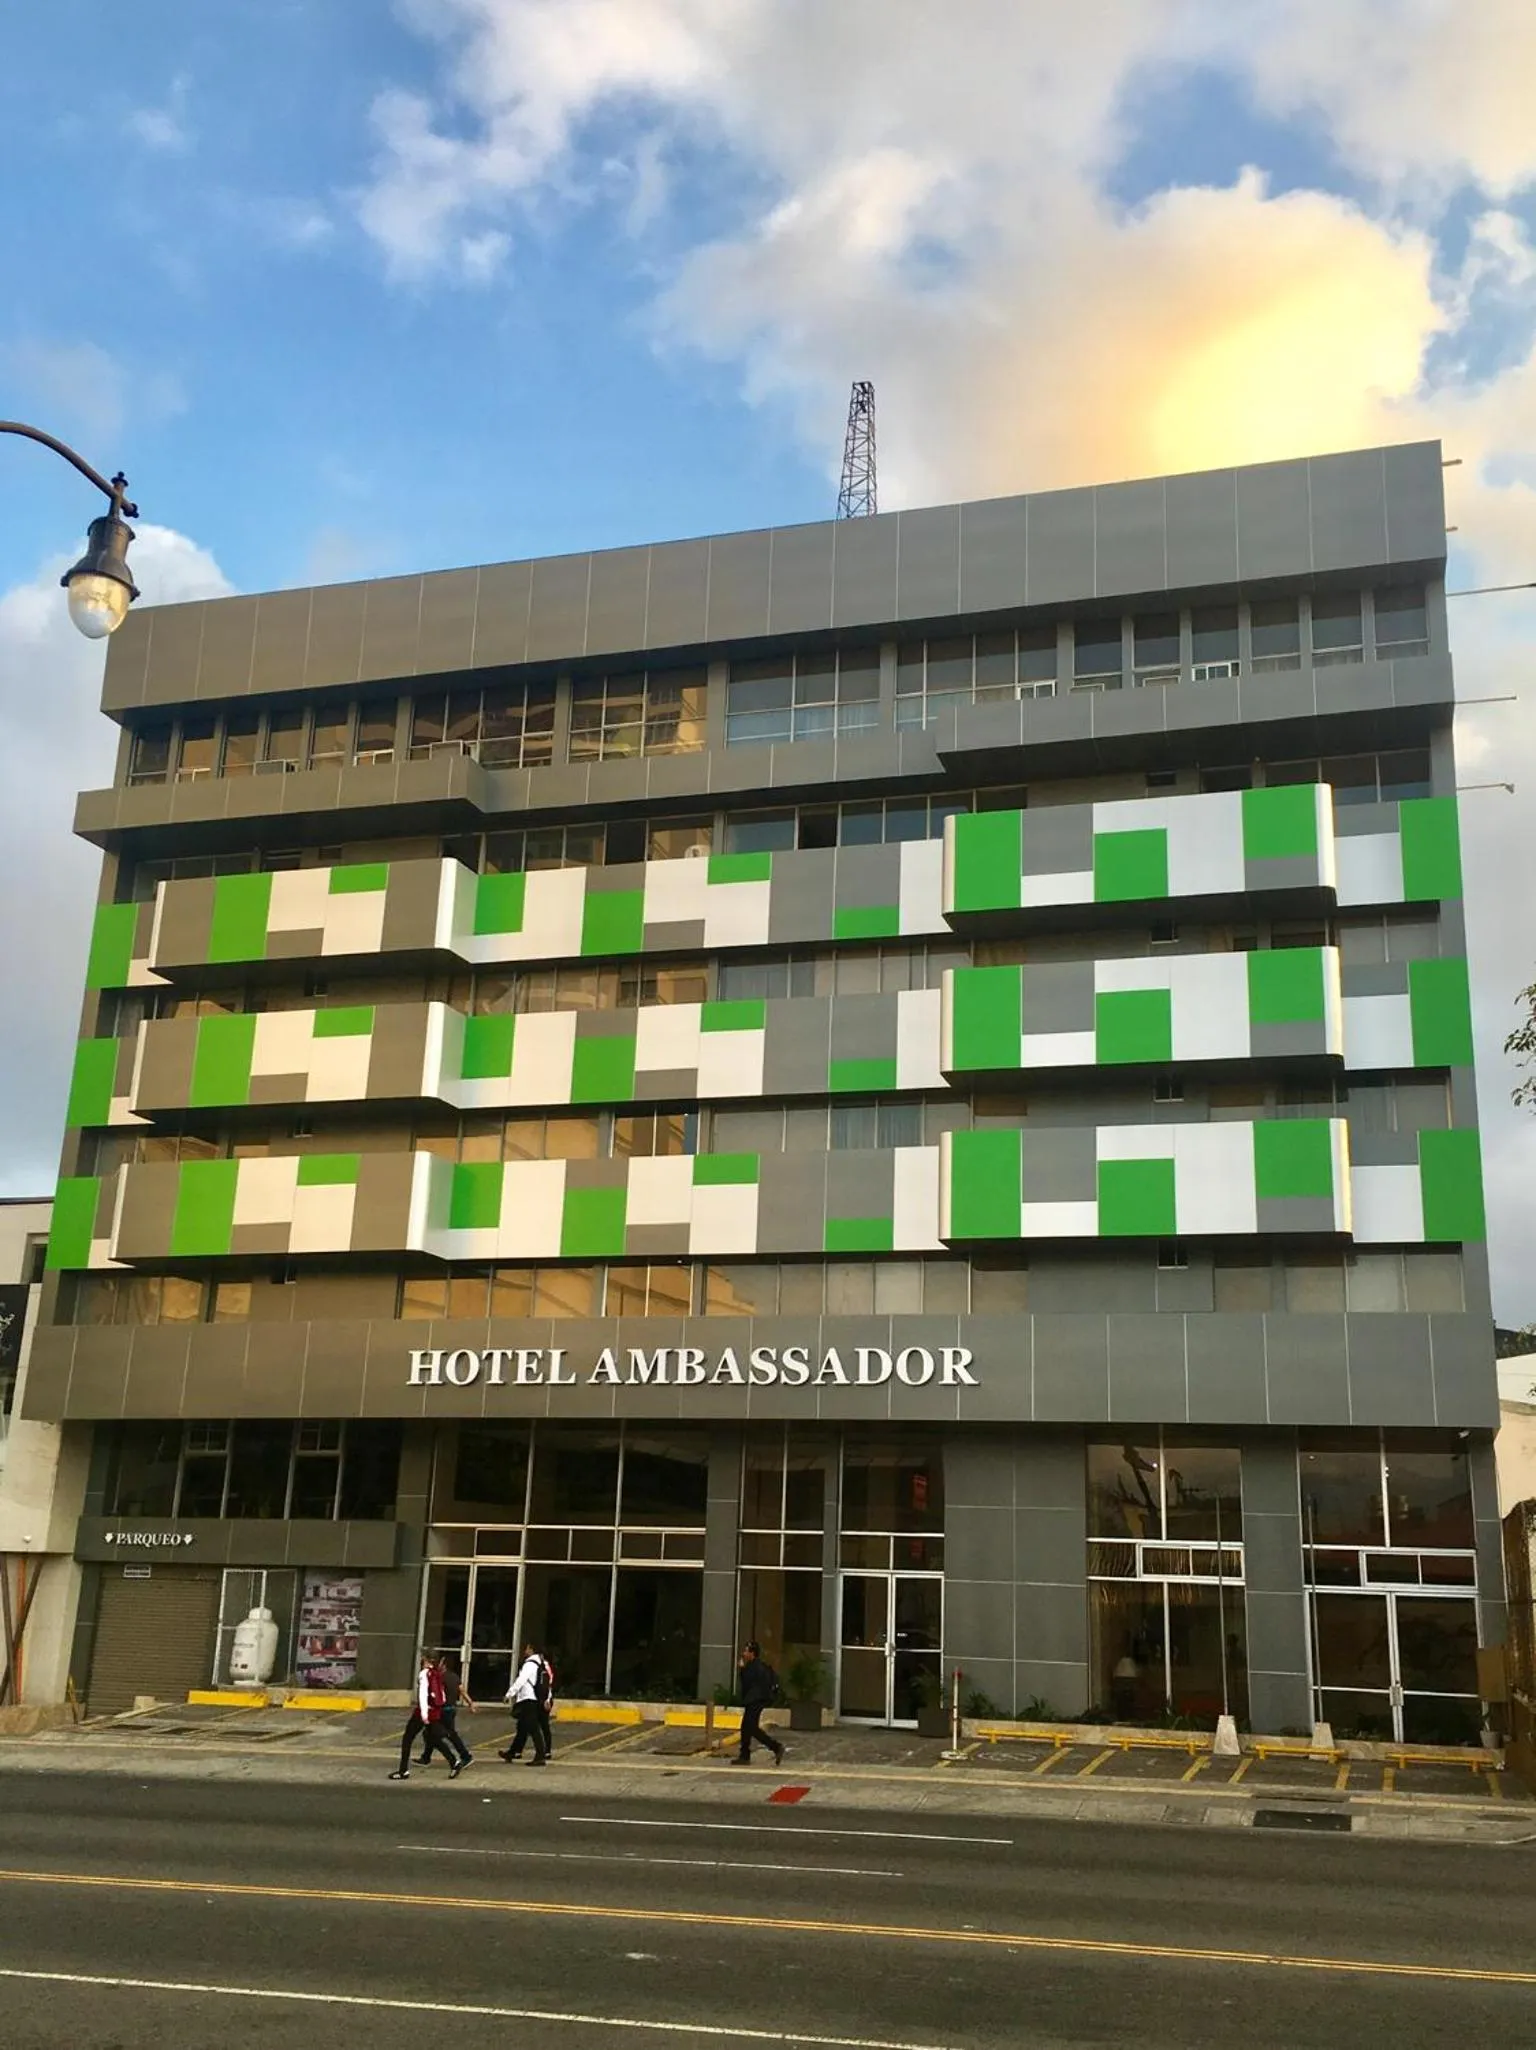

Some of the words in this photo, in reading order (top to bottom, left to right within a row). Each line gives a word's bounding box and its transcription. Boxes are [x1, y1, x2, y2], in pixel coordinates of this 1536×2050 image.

[406, 1349, 577, 1386] HOTEL
[586, 1346, 980, 1386] AMBASSADOR
[116, 1532, 182, 1548] PARQUEO
